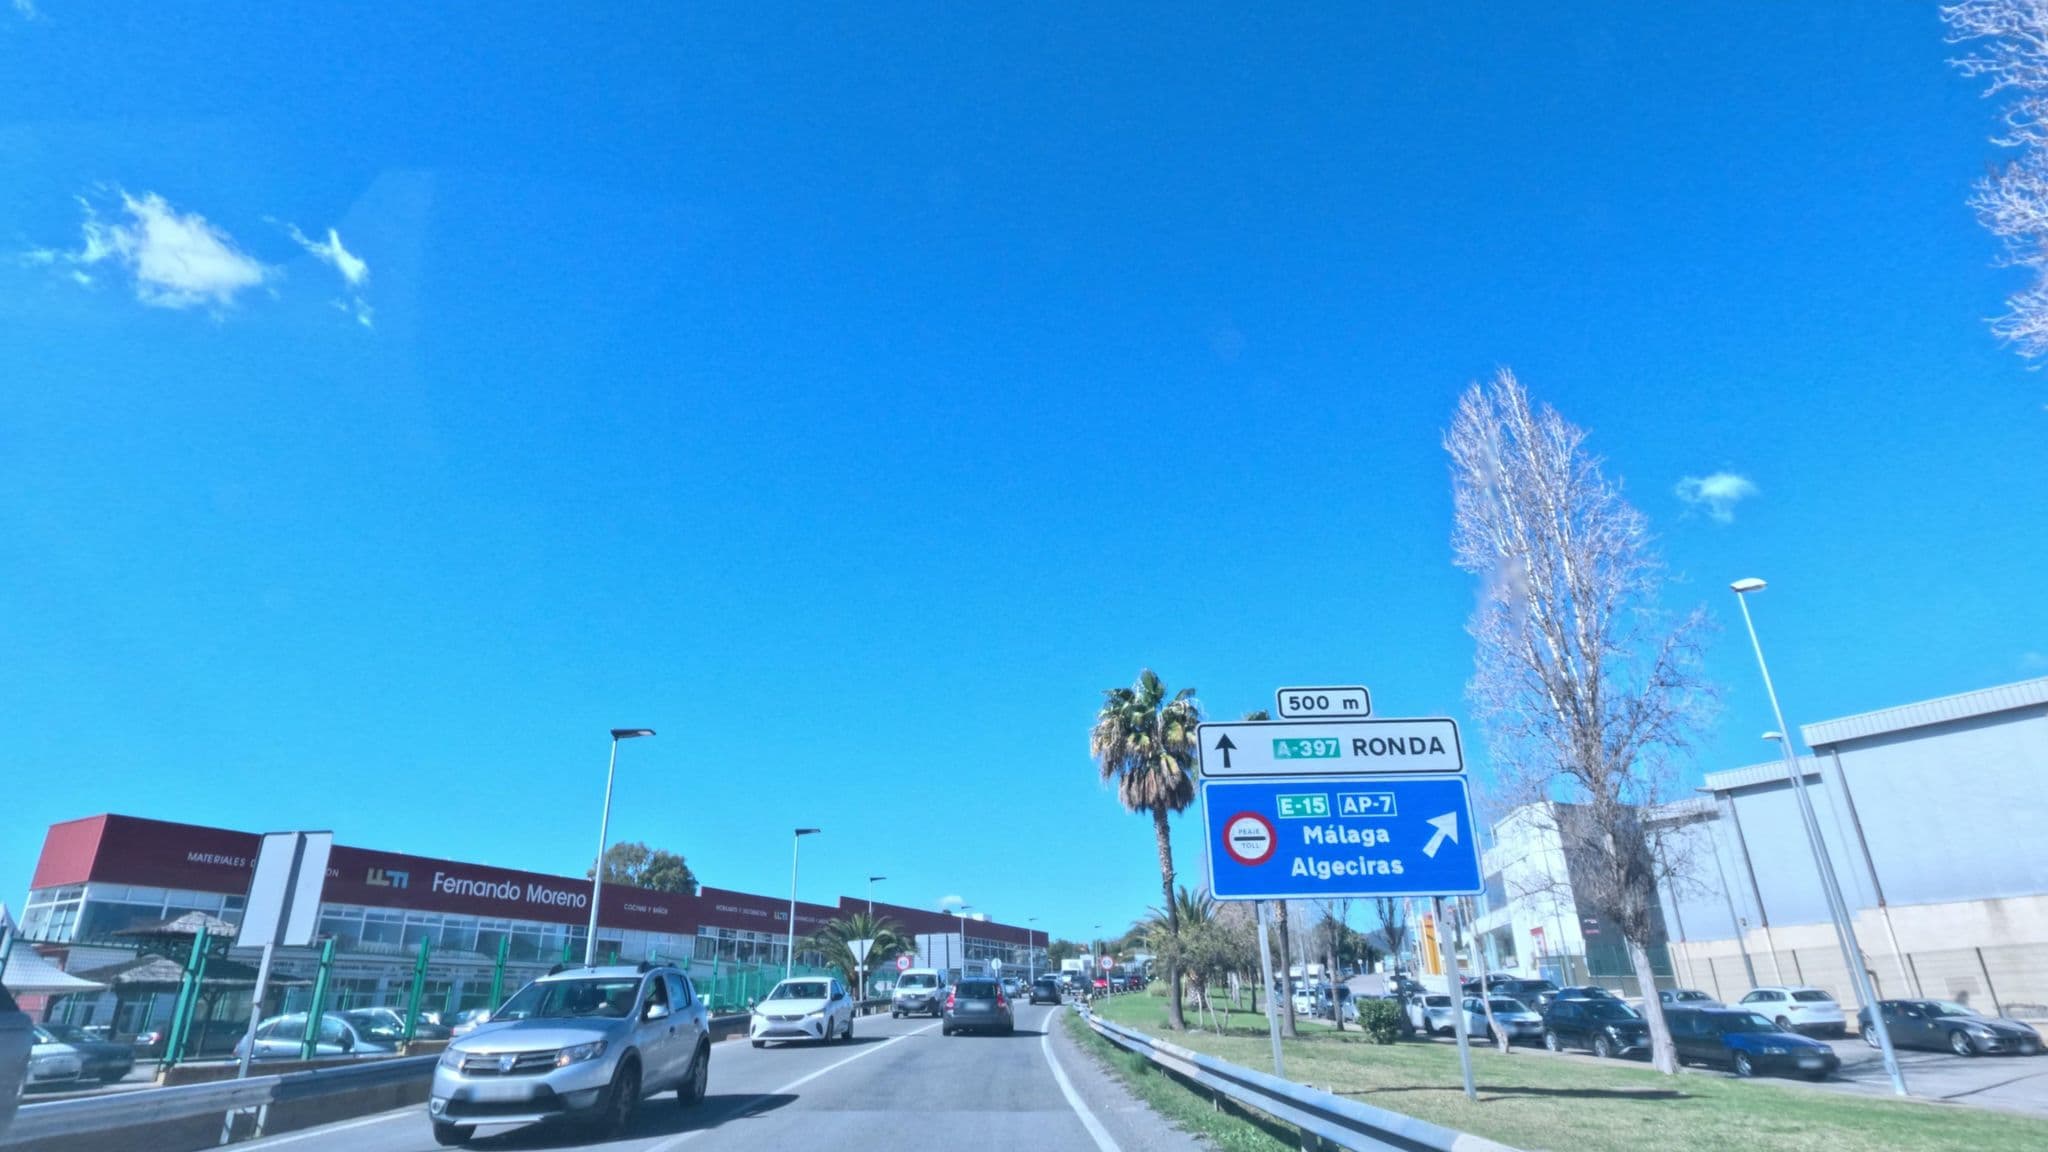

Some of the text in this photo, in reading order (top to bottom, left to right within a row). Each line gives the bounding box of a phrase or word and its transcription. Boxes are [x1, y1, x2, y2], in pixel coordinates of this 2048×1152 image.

[1289, 695, 1359, 711] 500 m
[1276, 736, 1446, 758] A-397 RONDA
[1279, 797, 1326, 815] E-15
[1343, 795, 1392, 814] AP-7
[1303, 824, 1391, 848] Málaga
[187, 851, 246, 868] MATERIALES
[1291, 855, 1405, 880] Algeciras
[431, 870, 521, 901] Fernando
[525, 882, 587, 909] Moreno
